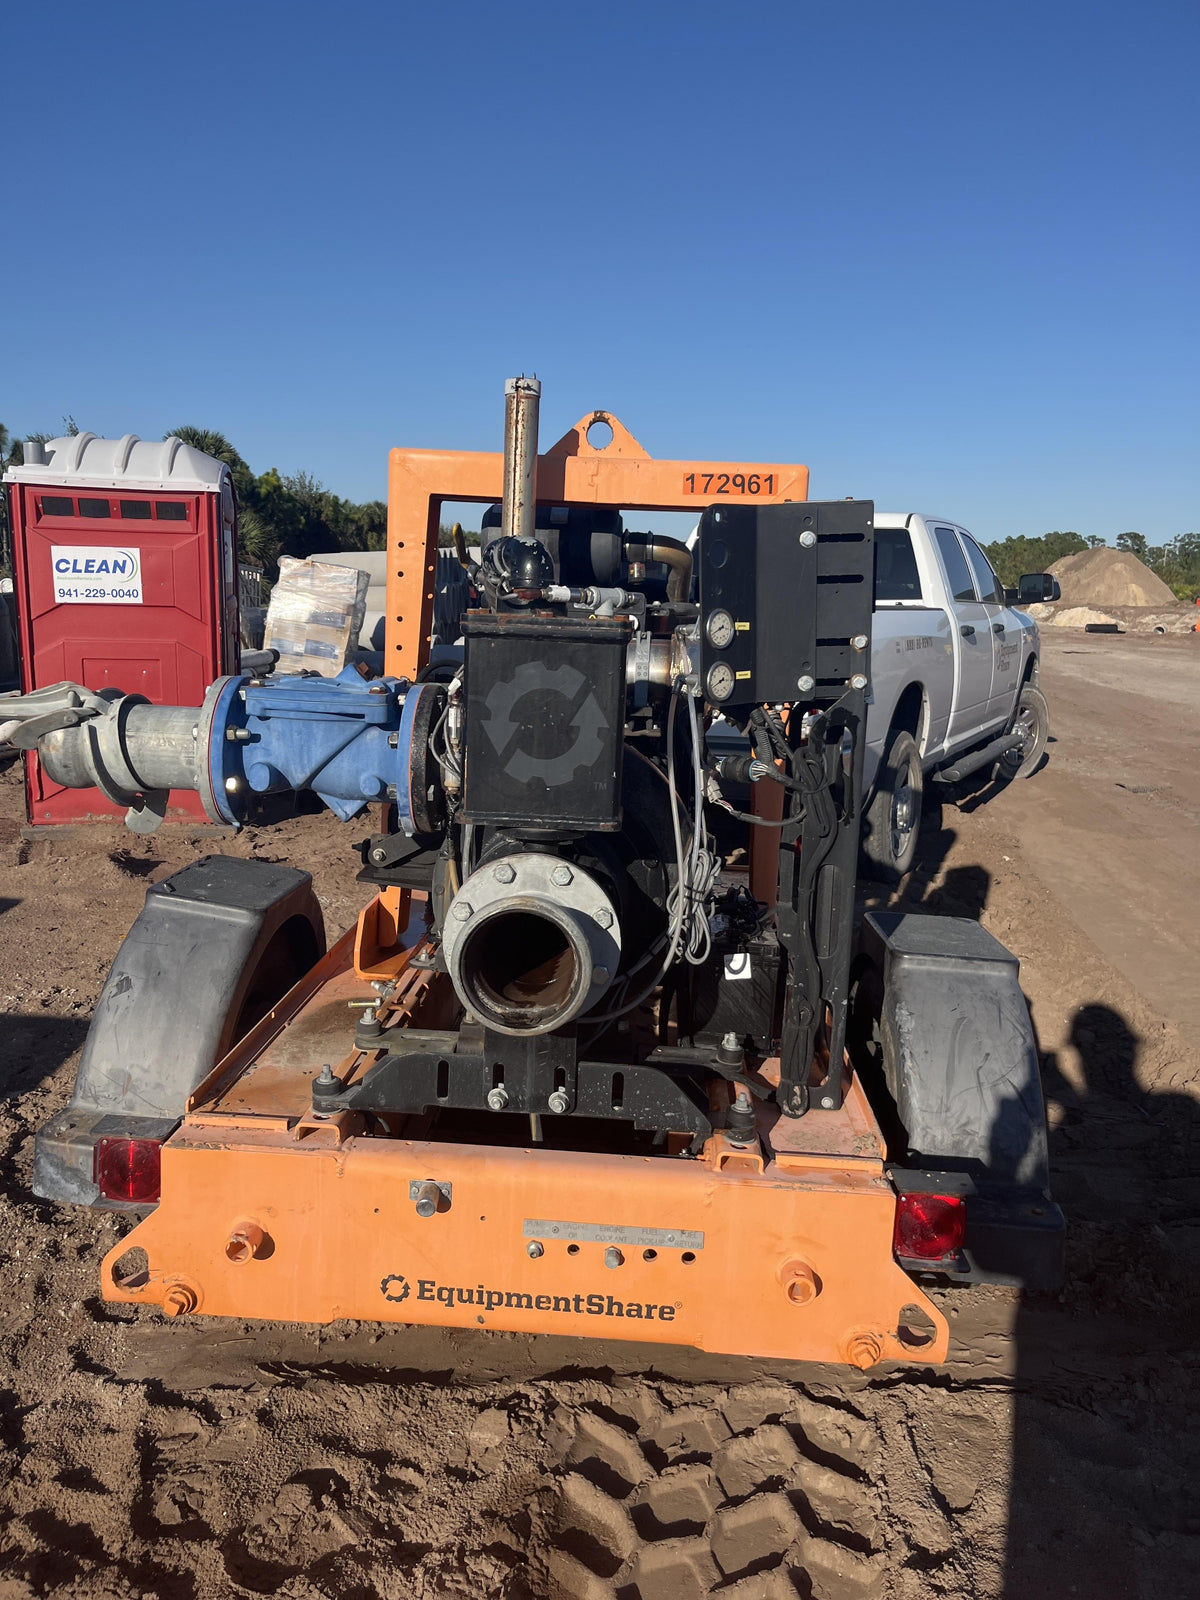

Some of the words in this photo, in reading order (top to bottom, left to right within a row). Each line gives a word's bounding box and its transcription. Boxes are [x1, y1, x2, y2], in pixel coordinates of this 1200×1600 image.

[685, 473, 774, 495] 172961
[55, 558, 127, 574] CLEAN
[58, 588, 139, 598] 941-229-0040
